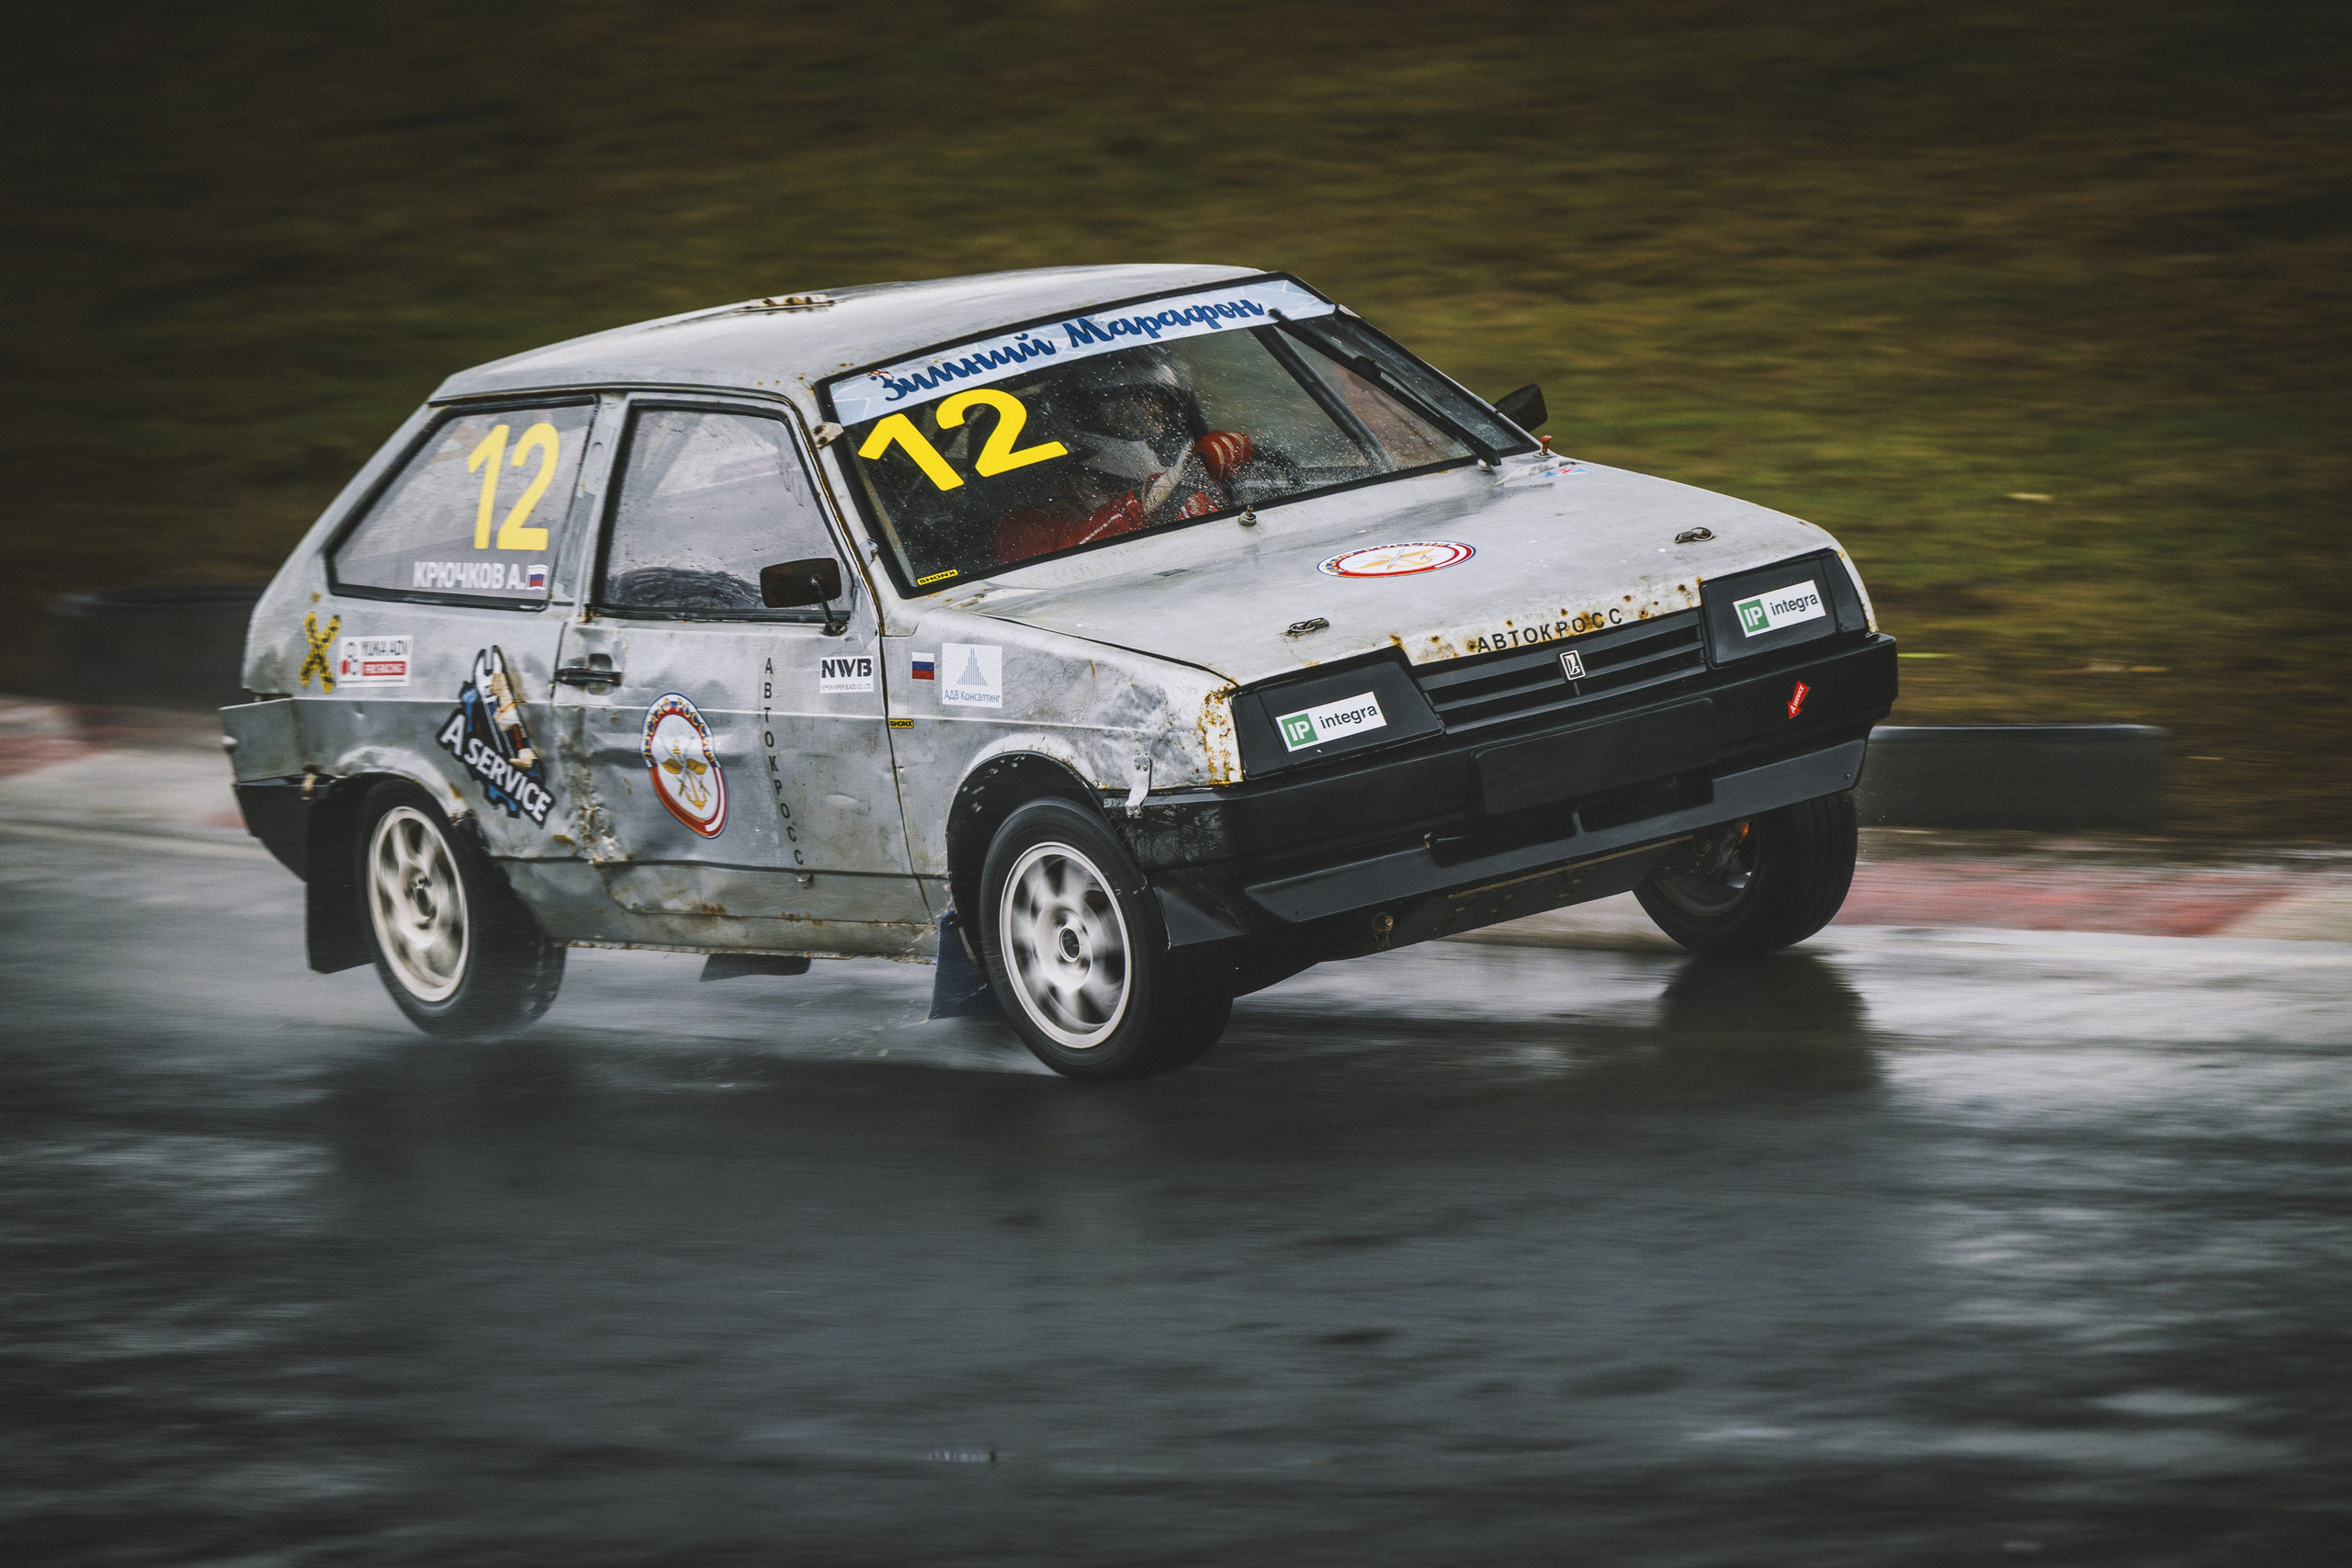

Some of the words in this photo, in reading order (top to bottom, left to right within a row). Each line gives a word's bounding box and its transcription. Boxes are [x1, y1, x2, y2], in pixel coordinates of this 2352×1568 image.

[869, 333, 1057, 401] Зимний
[1062, 298, 1267, 348] Марафон
[858, 389, 1069, 491] 12
[467, 423, 560, 550] 12
[413, 561, 505, 589] КРЮЧКОВ
[919, 570, 956, 584] SHONX
[1743, 606, 1763, 627] IP
[1770, 593, 1818, 616] integra
[1477, 607, 1623, 653] АВТОКРОСС
[821, 658, 872, 679] NWB
[944, 689, 959, 702] АДВ
[960, 691, 1001, 704] Консалтинг
[889, 719, 913, 728] SHONX
[1287, 720, 1310, 741] IP
[1318, 705, 1378, 729] integra
[440, 714, 467, 756] A
[464, 738, 551, 821] SERVICE
[764, 658, 804, 865] АВТОКРОСС
